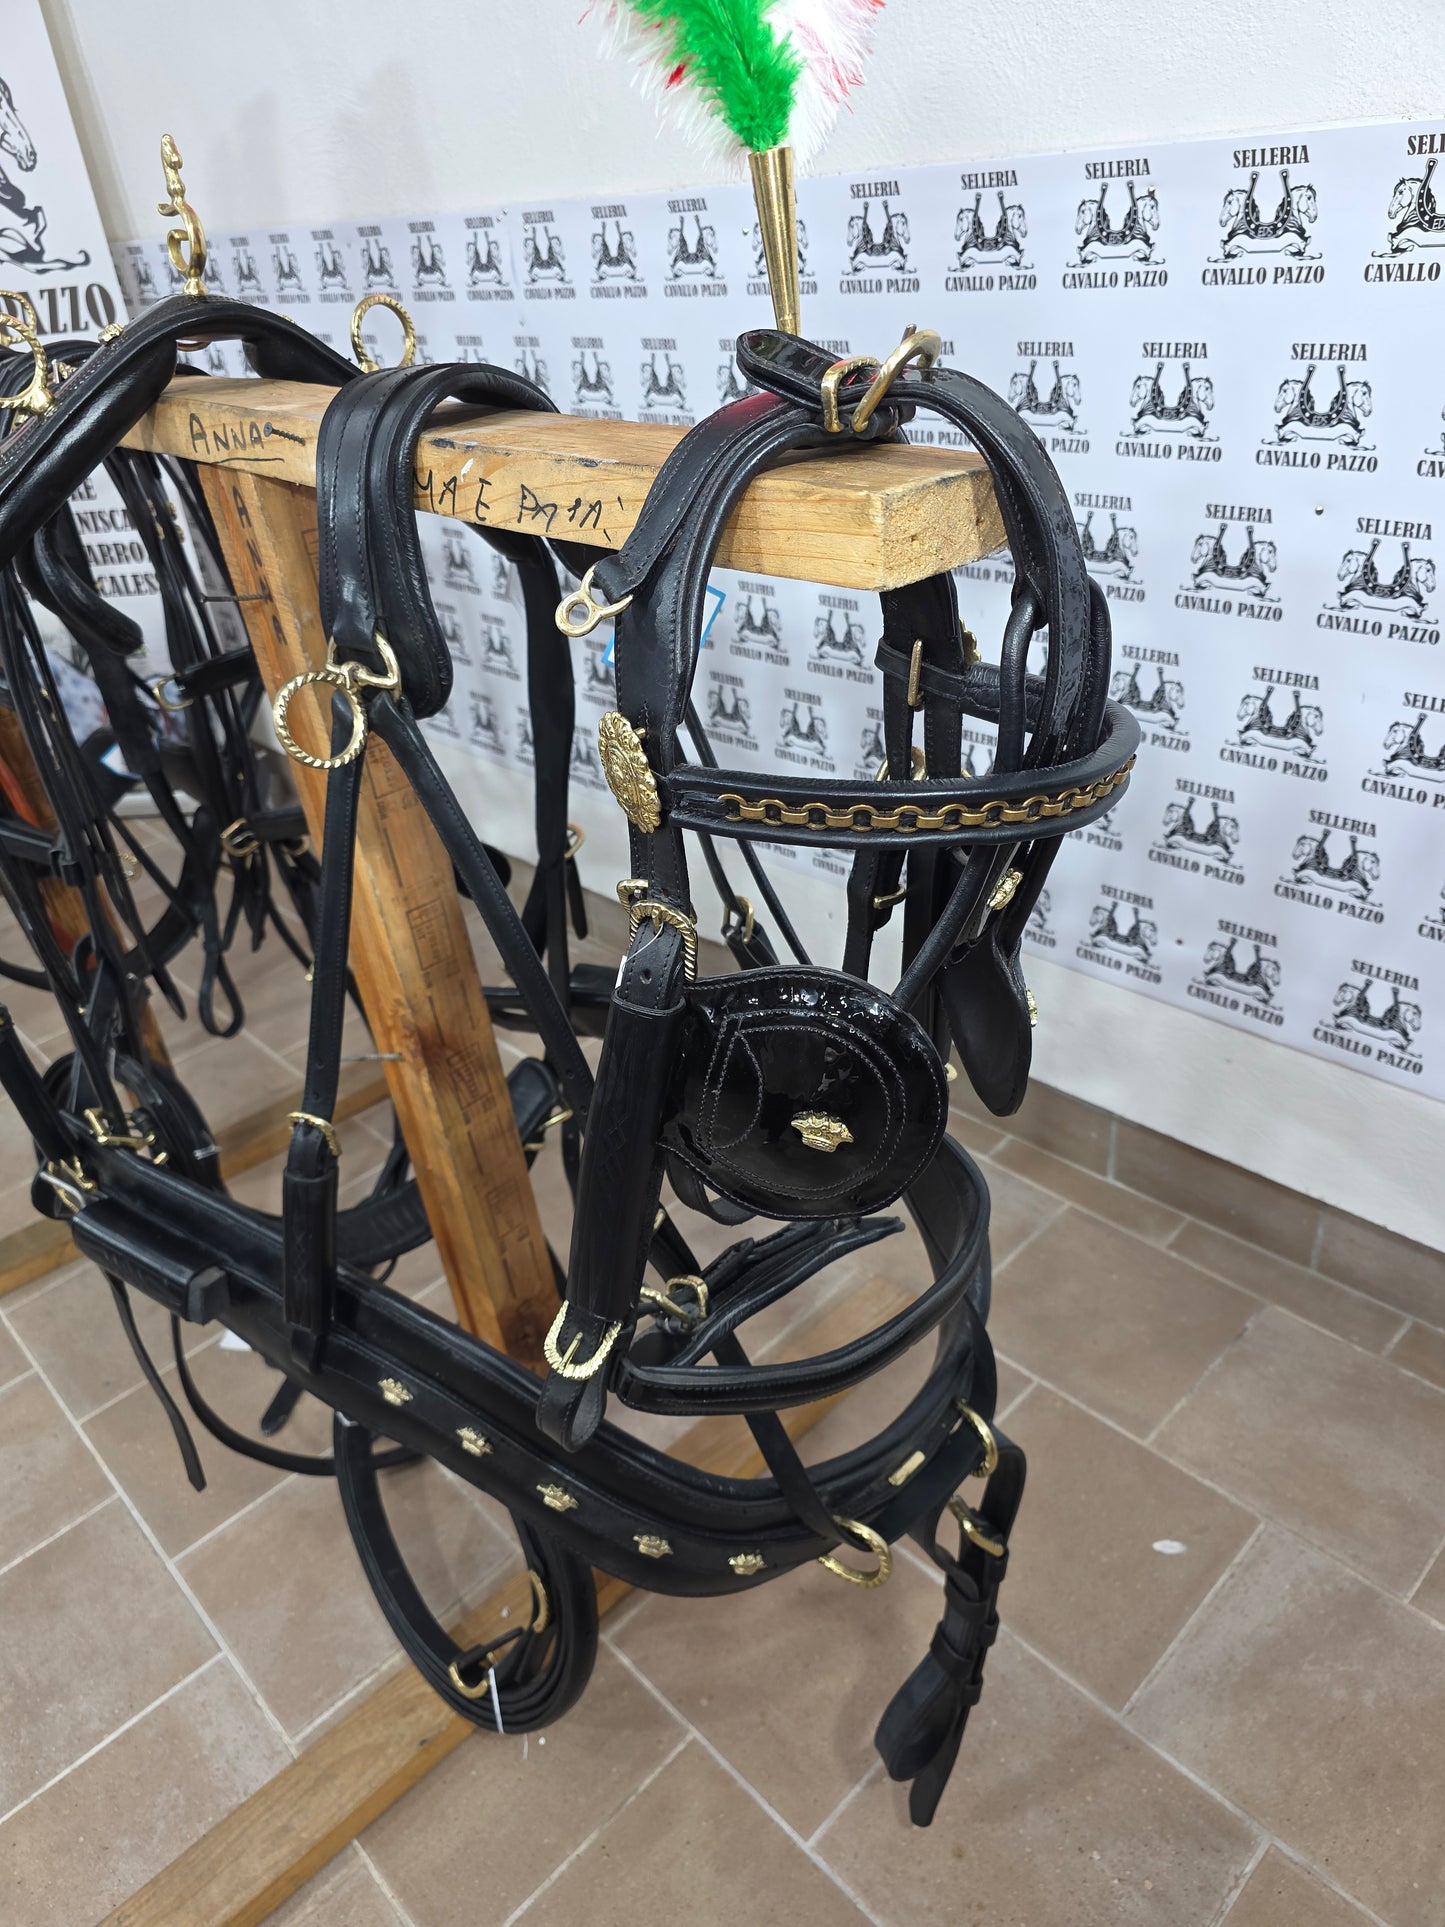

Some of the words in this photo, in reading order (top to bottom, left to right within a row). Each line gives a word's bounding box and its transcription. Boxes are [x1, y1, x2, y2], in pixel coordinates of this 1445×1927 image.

[1233, 145, 1309, 168] SELLERIA
[961, 170, 1018, 190] SELLERIA
[1085, 159, 1150, 180] SELLERIA
[850, 181, 900, 199] SELLERIA
[946, 275, 993, 292] CAVALLO
[999, 274, 1036, 290] PAZZO
[1063, 272, 1118, 289] CAVALLO
[1124, 270, 1168, 288] PAZZO
[1202, 268, 1266, 285] CAVALLO
[1273, 265, 1324, 284] PAZZO
[1364, 262, 1441, 282] CAVALLO
[840, 278, 882, 294] CAVALLO
[887, 278, 920, 293] PAZZO
[1017, 341, 1073, 357] SELLERIA
[1142, 342, 1207, 359] SELLERIA
[1291, 343, 1367, 361] SELLERIA
[188, 411, 265, 455] ANNA
[1051, 438, 1089, 454] PAZZO
[1116, 441, 1171, 460] CAVALLO
[1178, 444, 1221, 462] PAZZO
[1256, 449, 1321, 468] CAVALLO
[1327, 453, 1378, 473] PAZZO
[1074, 493, 1132, 511] SELLERIA
[1205, 504, 1273, 524] SELLERIA
[1357, 517, 1432, 540] SELLERIA
[1106, 584, 1145, 602] PAZZO
[1175, 594, 1231, 615] CAVALLO
[1238, 602, 1283, 622] PAZZO
[1317, 614, 1382, 636] CAVALLO
[1388, 623, 1440, 645] PAZZO
[1121, 645, 1179, 667] SELLERIA
[1253, 667, 1319, 690] SELLERIA
[1150, 734, 1190, 753] PAZZO
[1219, 748, 1277, 772] CAVALLO
[1283, 760, 1328, 782] PAZZO
[1176, 778, 1235, 803] SELLERIA
[1362, 778, 1427, 804] CAVALLO
[1309, 809, 1377, 838] SELLERIA
[1148, 850, 1200, 873] CAVALLO
[1204, 865, 1245, 886] PAZZO
[1100, 884, 1153, 910] SELLERIA
[1274, 883, 1333, 909] CAVALLO
[1337, 901, 1384, 925] PAZZO
[1218, 919, 1277, 947] SELLERIA
[1351, 959, 1419, 991] SELLERIA
[1187, 984, 1240, 1010] CAVALLO
[1243, 1003, 1284, 1027] PAZZO
[1313, 1027, 1372, 1057] CAVALLO
[1377, 1049, 1423, 1075] PAZZO
